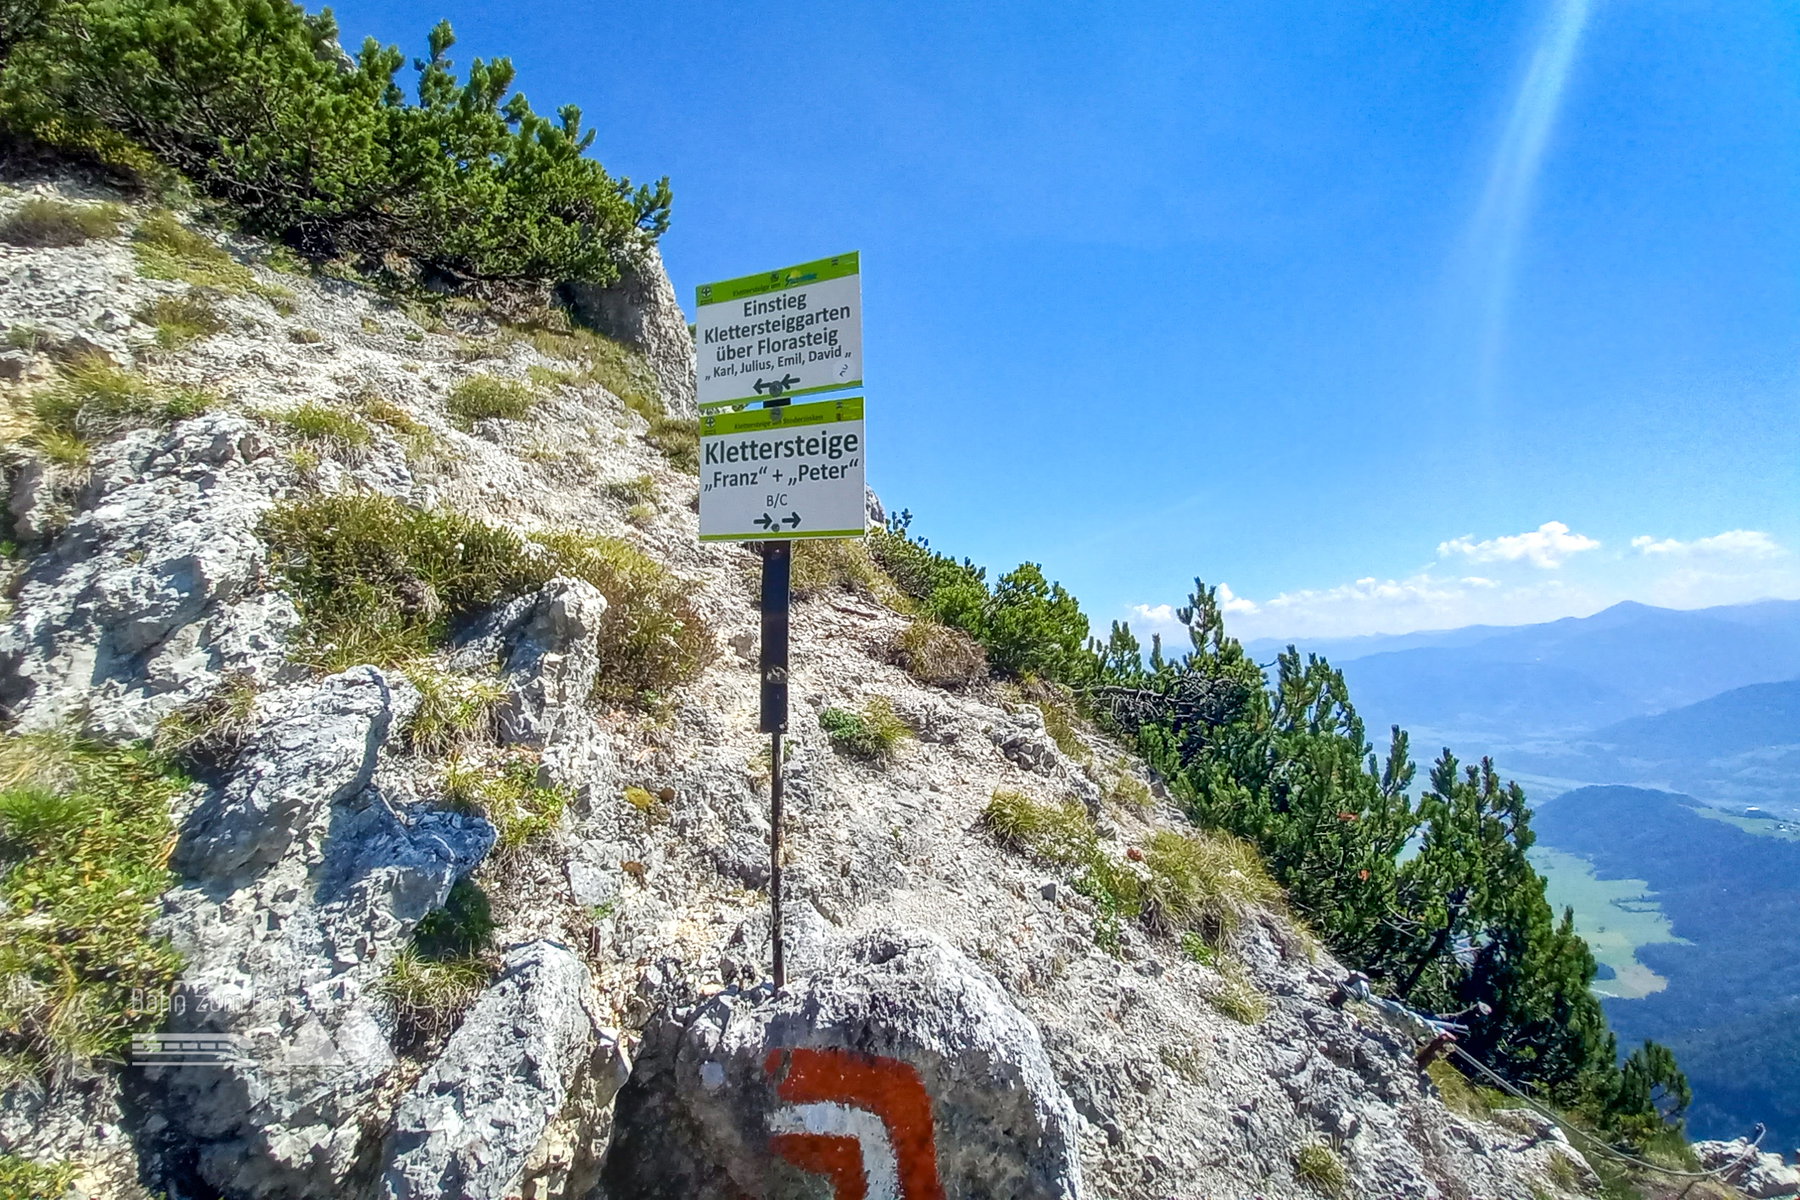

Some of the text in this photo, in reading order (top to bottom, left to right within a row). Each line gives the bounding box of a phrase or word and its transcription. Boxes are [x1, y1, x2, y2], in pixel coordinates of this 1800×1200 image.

[744, 293, 807, 318] Einstieg
[705, 306, 850, 344] Klettersteiggarten
[717, 328, 838, 362] über Florasteig
[714, 365, 738, 378] Karl,
[740, 360, 774, 373] Julius,
[778, 354, 805, 367] Emil,
[706, 430, 858, 464] Klettersteige
[772, 469, 783, 482] +
[766, 494, 788, 508] B/C
